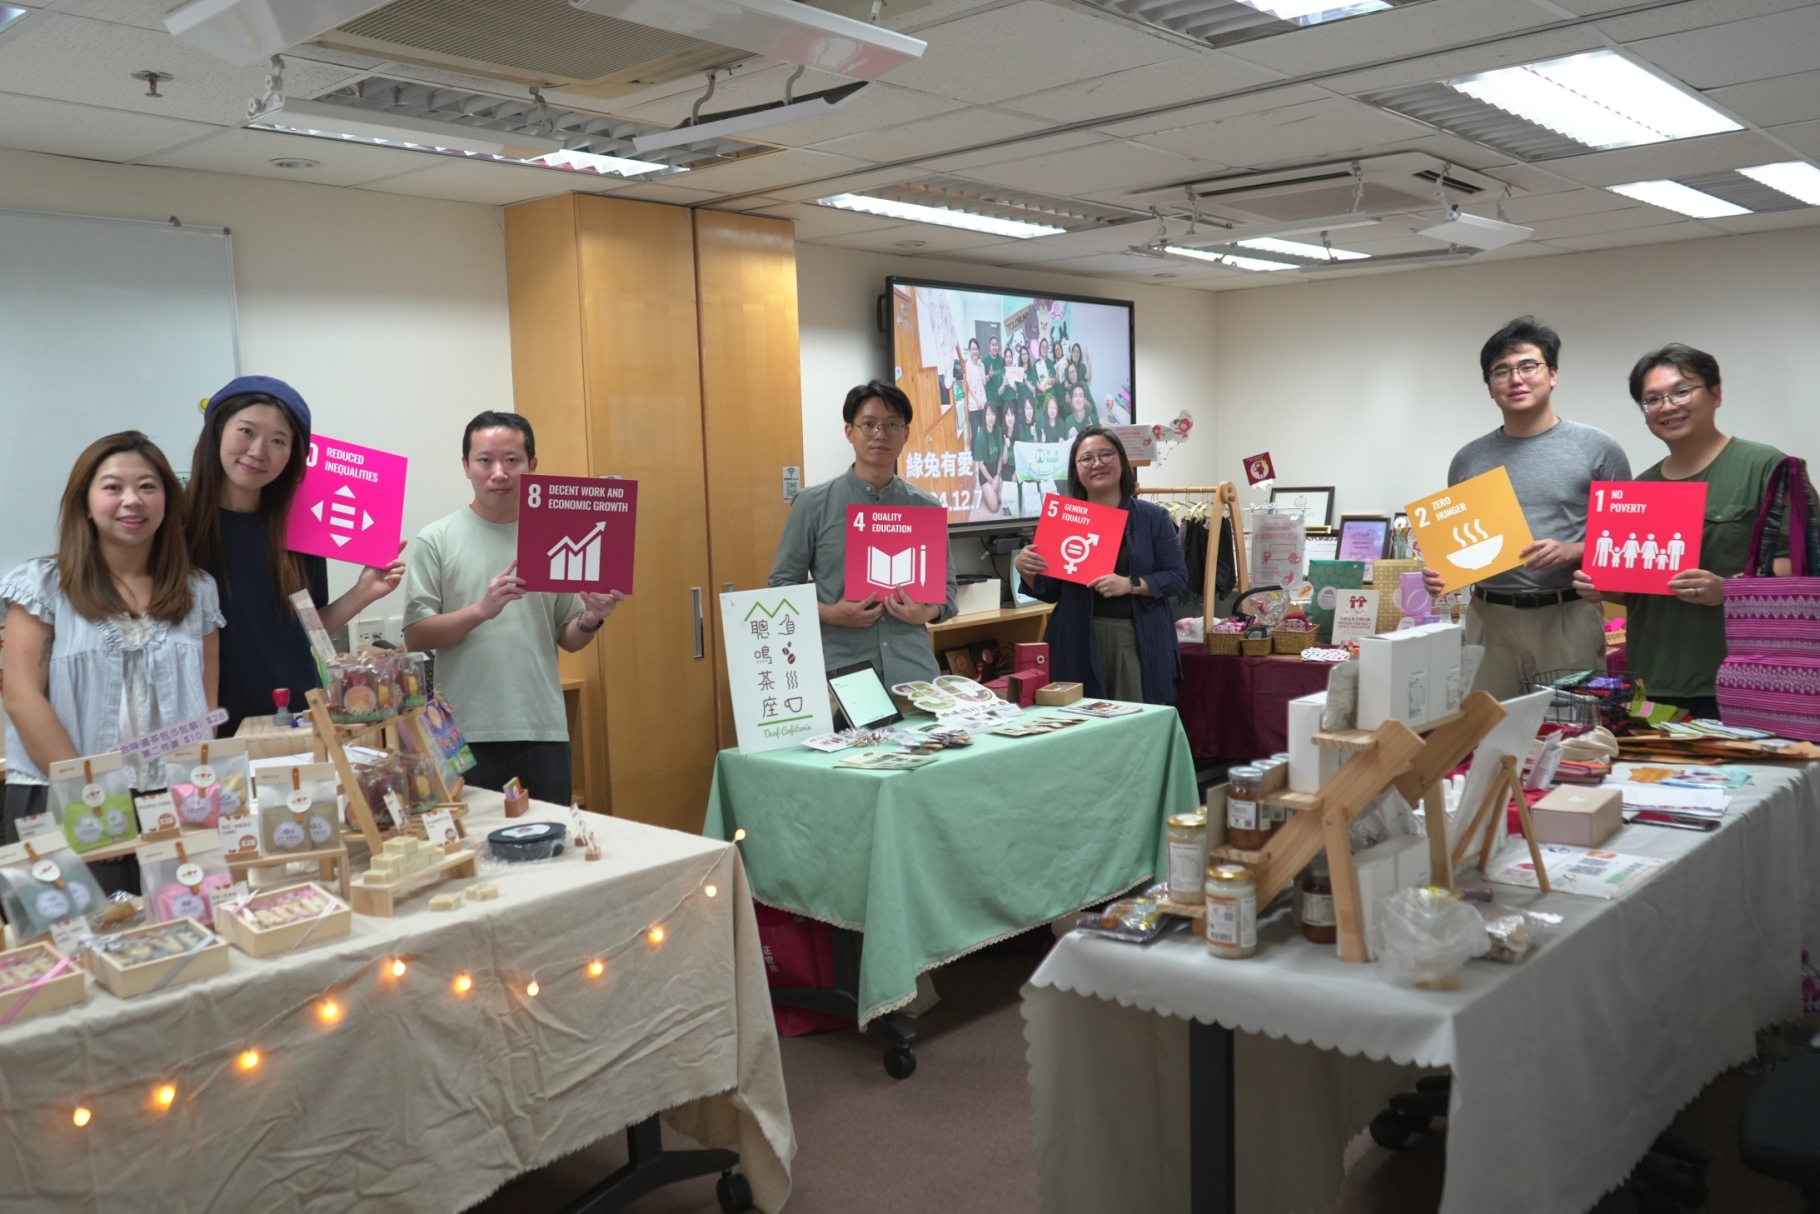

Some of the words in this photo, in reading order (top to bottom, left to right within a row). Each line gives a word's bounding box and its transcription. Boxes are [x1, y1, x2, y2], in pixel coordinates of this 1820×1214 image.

[326, 447, 364, 465] REDUCED
[325, 461, 378, 482] INEQUALITIES
[527, 483, 541, 508] 8
[549, 485, 579, 496] DECENT
[581, 486, 606, 497] WORK
[607, 488, 624, 498] AND
[1611, 490, 1623, 499] NO
[548, 499, 591, 511] ECONOMIC
[593, 501, 628, 513] GROWTH
[1431, 496, 1452, 511] ZERO
[1595, 490, 1604, 512] 1
[1610, 503, 1647, 513] POVERTY
[1047, 500, 1059, 518] 5
[1064, 503, 1088, 515] GENDER
[1435, 502, 1467, 521] HUNGER
[853, 512, 866, 532] 4
[872, 512, 902, 522] QUALITY
[1061, 513, 1091, 525] EQUALITY
[1414, 506, 1431, 528] 2
[872, 523, 912, 533] EDUCATION
[205, 711, 226, 725] $28
[183, 732, 203, 744] $10
[763, 727, 780, 739] Deaf
[781, 723, 812, 737] Cafeteria
